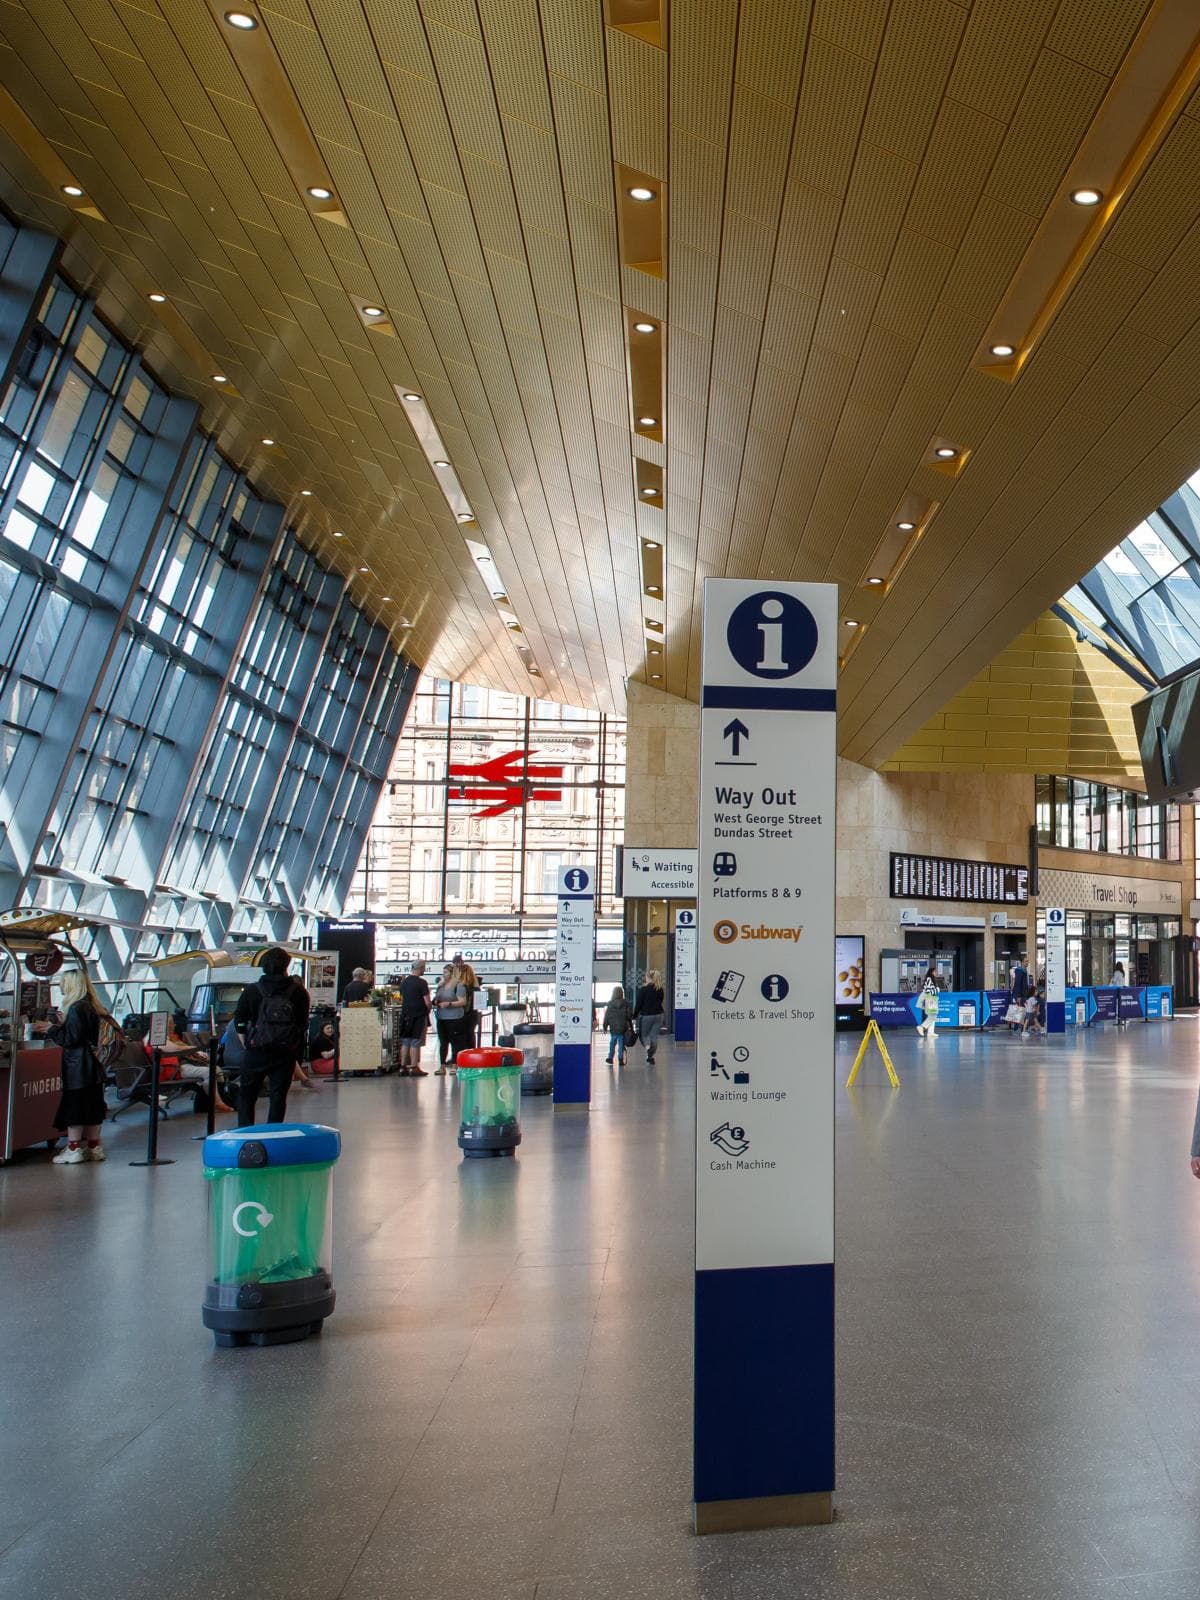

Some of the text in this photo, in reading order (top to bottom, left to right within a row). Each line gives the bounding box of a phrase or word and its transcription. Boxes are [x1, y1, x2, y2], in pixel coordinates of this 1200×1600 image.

[715, 787, 796, 809] Way Out
[714, 813, 822, 826] West George Street
[714, 828, 792, 839] Dundas Street
[654, 863, 693, 873] Waiting
[713, 888, 802, 898] Platforms 8 & 9
[1092, 884, 1116, 902] Travel
[1119, 887, 1138, 908] Shop
[741, 924, 802, 943] Subway
[711, 1010, 815, 1020] Tickets & Travel Shop
[711, 1090, 786, 1102] Waiting Lounge
[710, 1160, 776, 1170] Cash Machine
